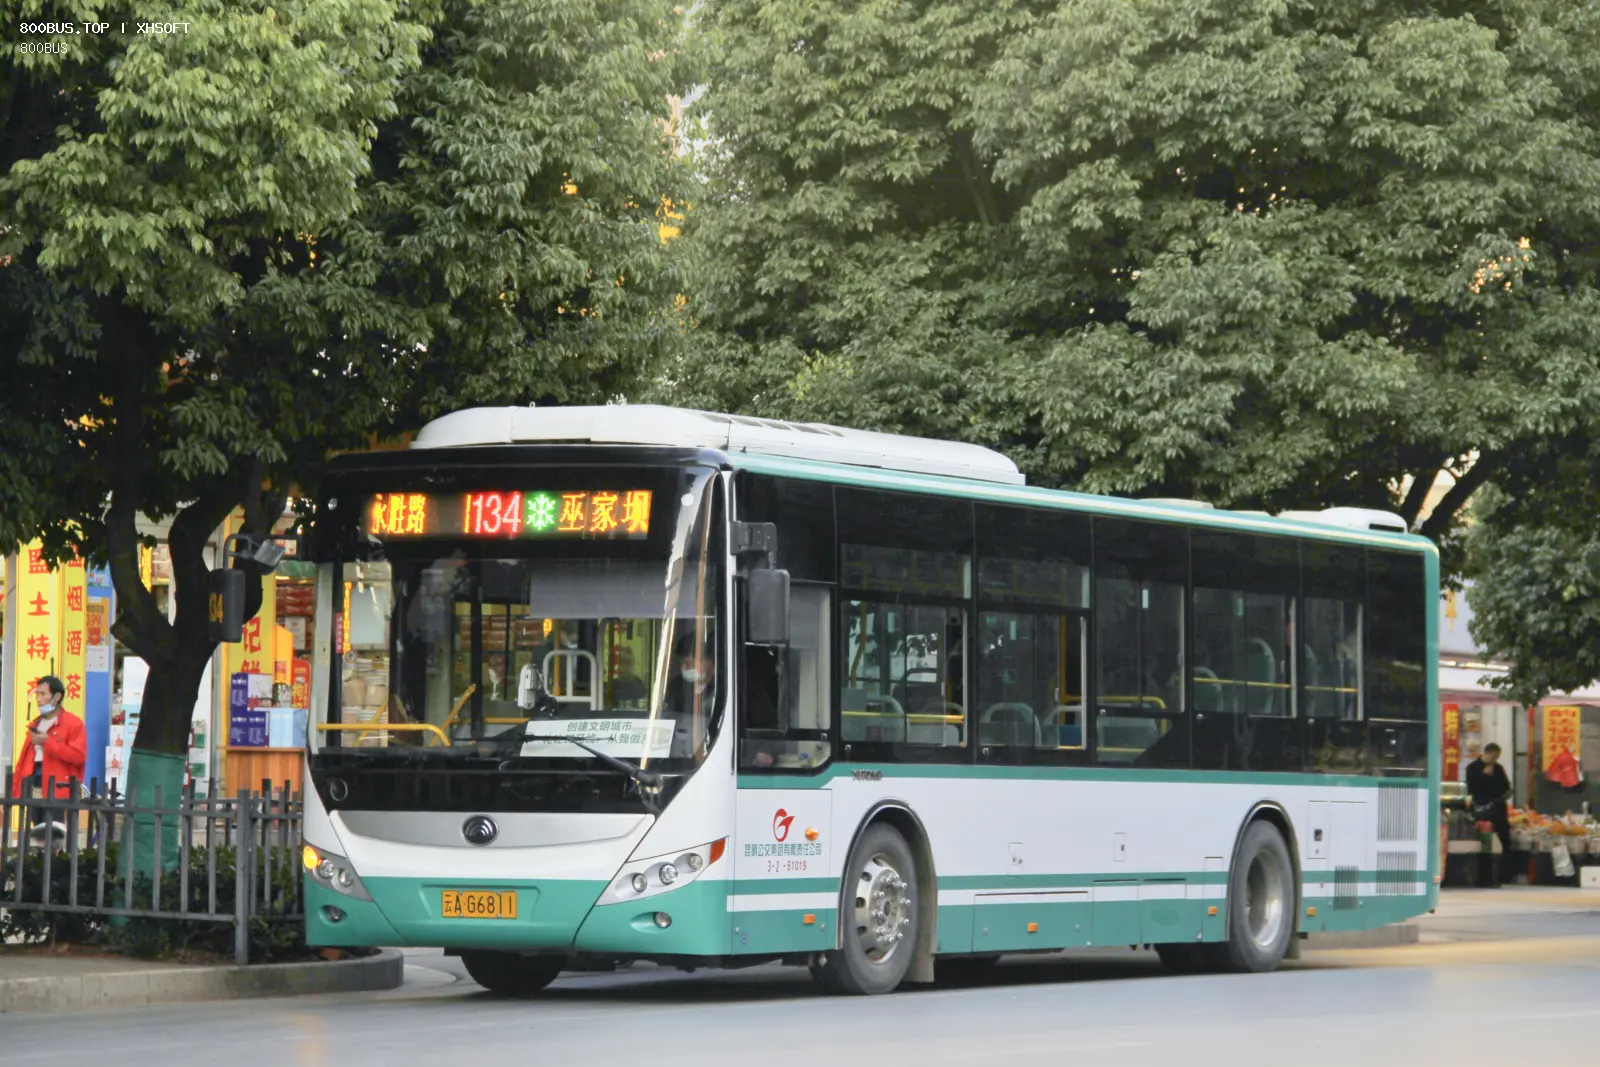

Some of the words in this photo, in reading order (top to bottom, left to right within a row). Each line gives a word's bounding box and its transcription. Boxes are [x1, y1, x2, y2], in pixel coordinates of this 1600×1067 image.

[473, 493, 522, 533] 134
[558, 492, 652, 533] 巫家坝
[567, 721, 633, 732] 创建文明城市
[744, 843, 822, 857] 昆明公交集团有限责任公司
